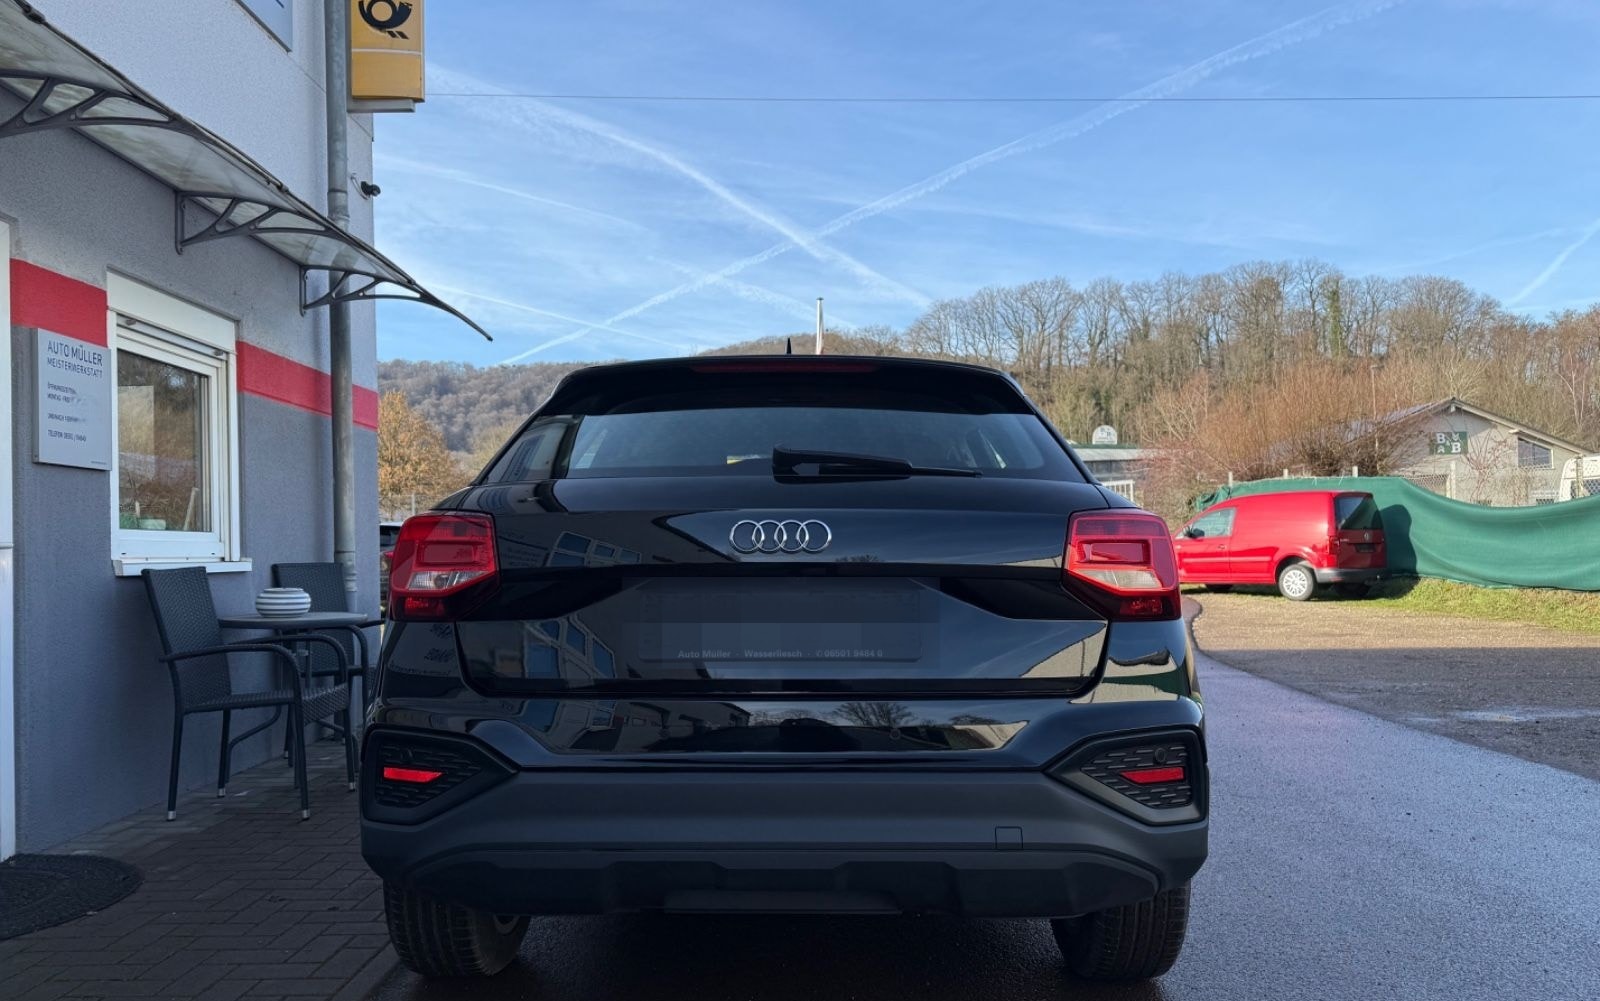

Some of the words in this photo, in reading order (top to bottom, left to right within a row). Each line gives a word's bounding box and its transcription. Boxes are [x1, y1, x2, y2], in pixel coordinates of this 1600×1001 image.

[47, 340, 69, 358] AUTO
[71, 344, 103, 367] MÜLLER
[678, 650, 700, 658] Auto
